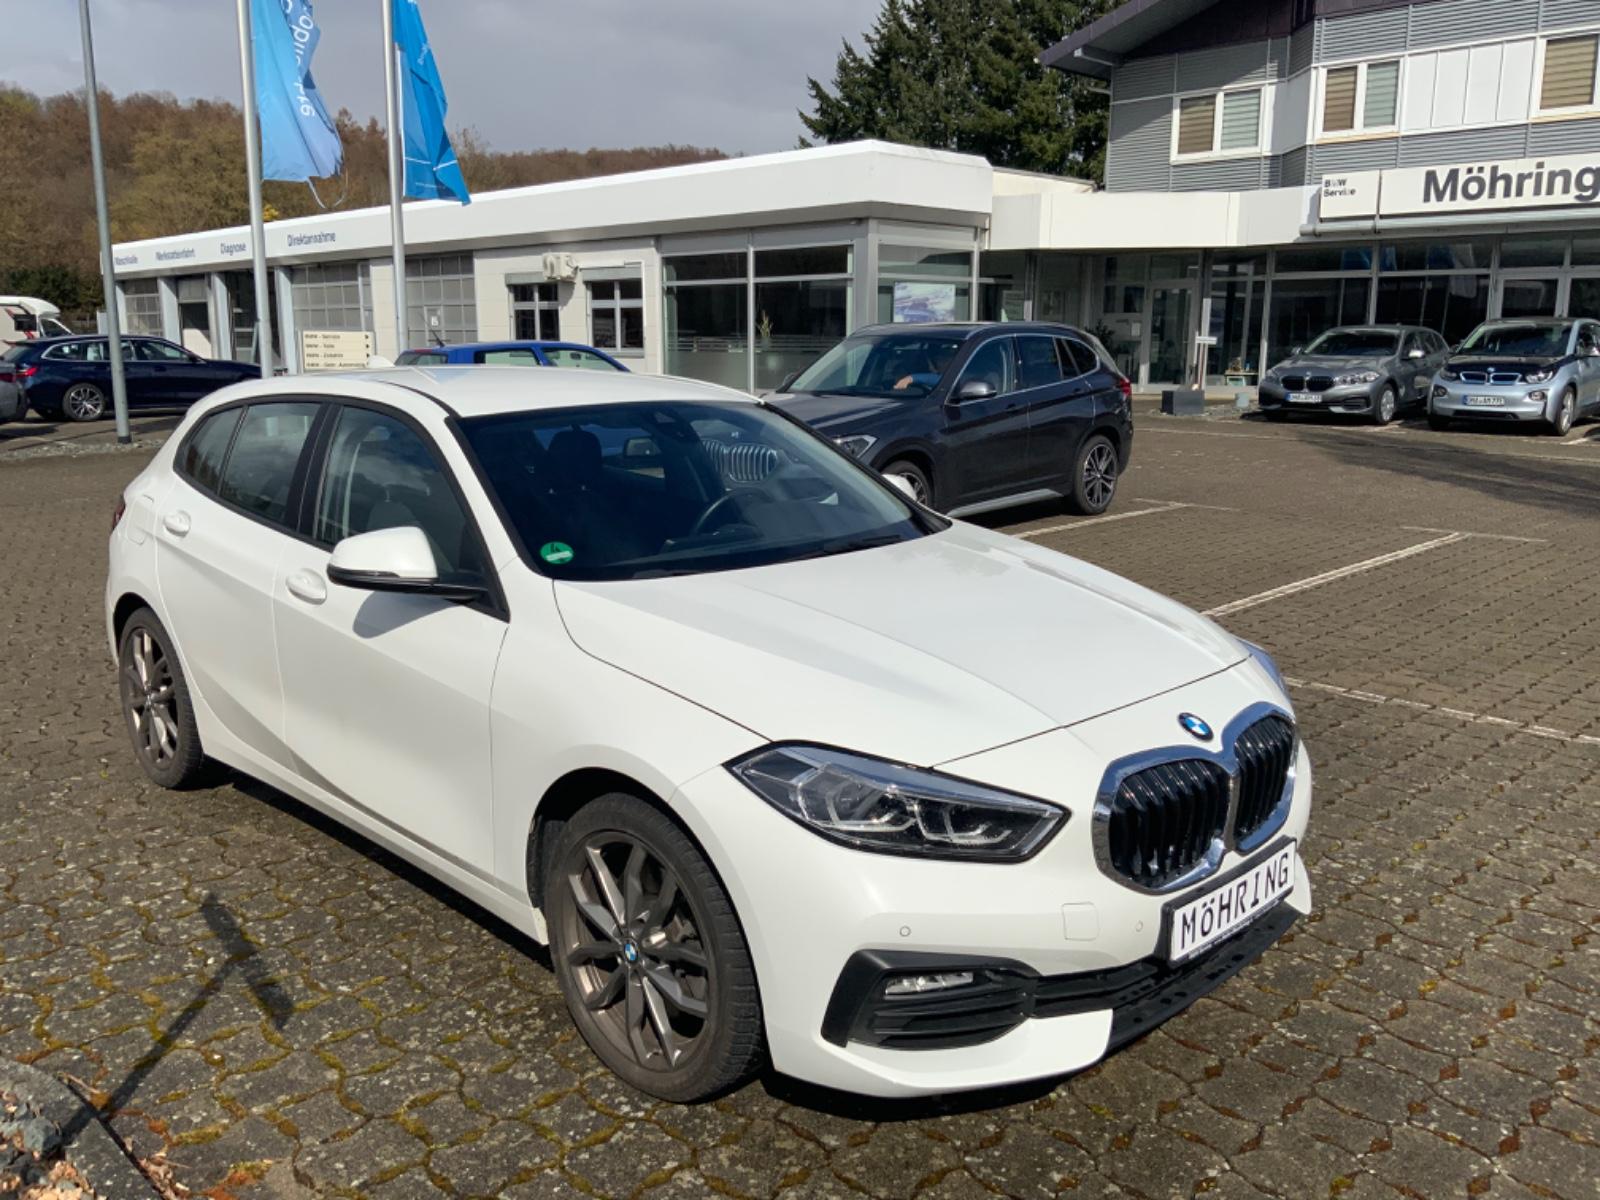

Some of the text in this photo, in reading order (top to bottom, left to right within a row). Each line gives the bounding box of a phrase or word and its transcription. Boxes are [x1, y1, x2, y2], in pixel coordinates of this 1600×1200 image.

[1423, 161, 1600, 203] Möhring
[220, 242, 247, 256] Diagnose
[287, 232, 336, 247] Direktannahme
[1181, 852, 1289, 949] MÖHRING
